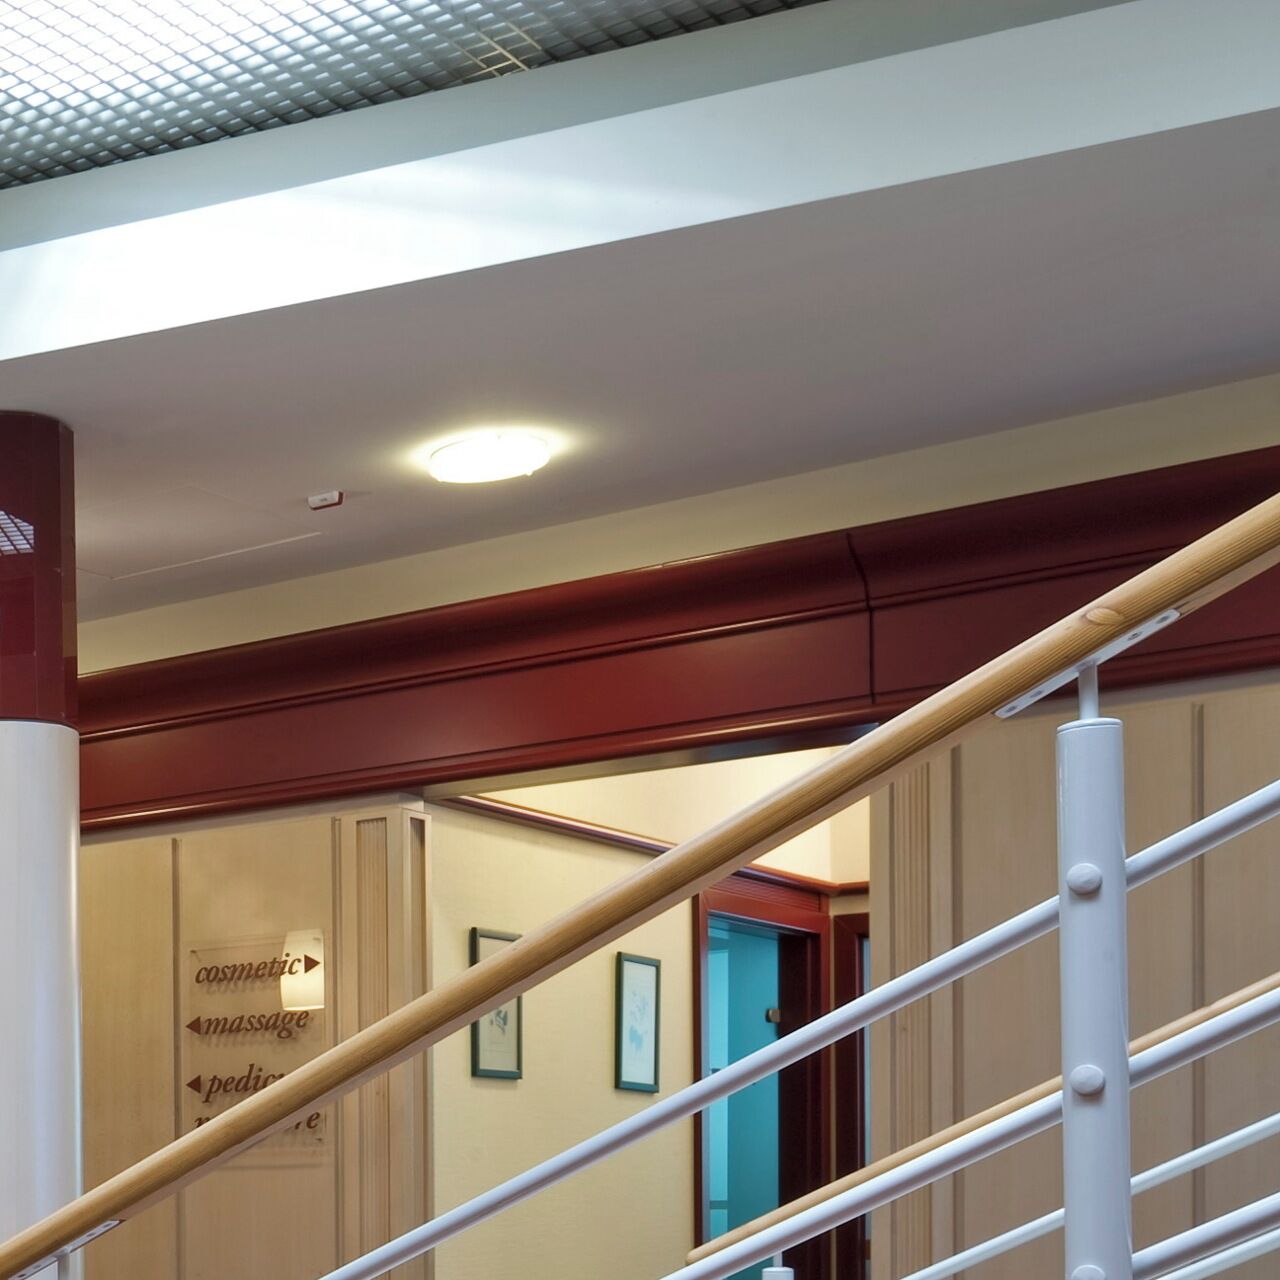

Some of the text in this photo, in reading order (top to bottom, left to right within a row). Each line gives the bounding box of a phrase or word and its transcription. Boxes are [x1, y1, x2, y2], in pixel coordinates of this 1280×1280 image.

[195, 952, 302, 984] cosmetic
[203, 1010, 310, 1039] massage
[202, 1063, 287, 1103] pedic
